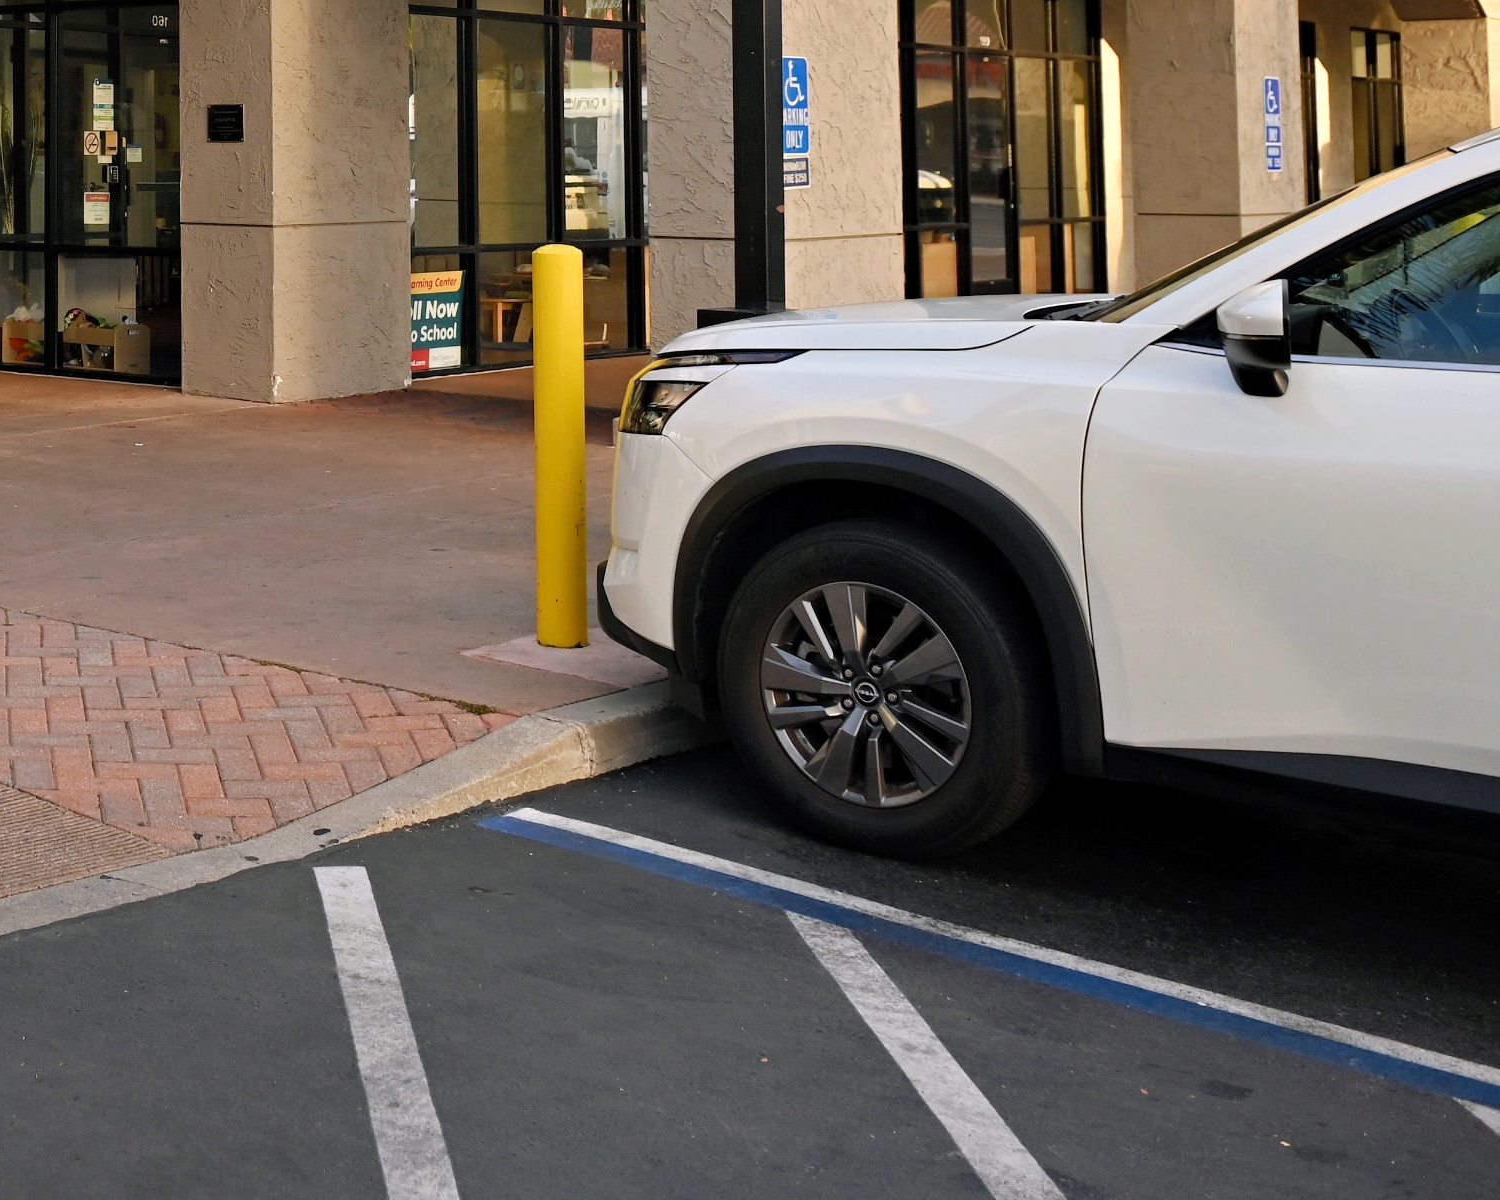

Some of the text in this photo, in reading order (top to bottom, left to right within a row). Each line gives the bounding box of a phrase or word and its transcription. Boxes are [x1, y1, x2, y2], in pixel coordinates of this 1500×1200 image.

[782, 108, 808, 126] ARKING
[786, 130, 804, 149] ONLY
[411, 277, 457, 290] arning Center
[425, 299, 459, 319] Now
[420, 321, 457, 342] School
